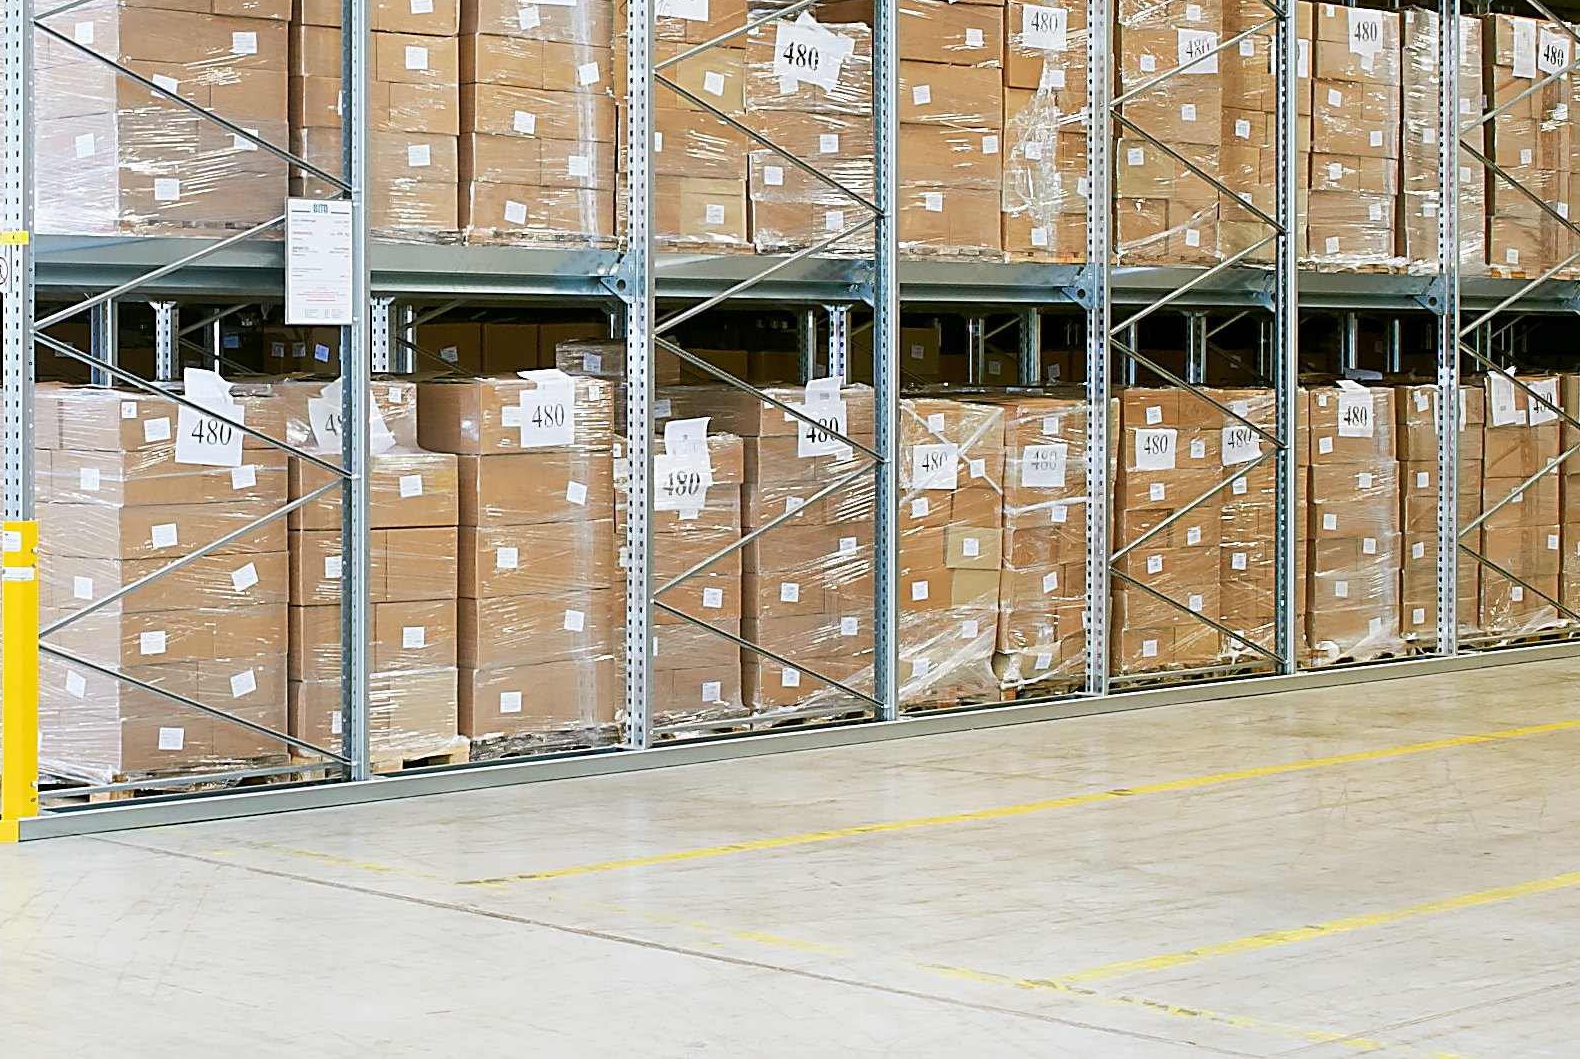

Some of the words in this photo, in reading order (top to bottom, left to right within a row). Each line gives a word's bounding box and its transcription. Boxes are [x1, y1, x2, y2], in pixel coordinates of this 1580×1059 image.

[1031, 12, 1059, 34] 480
[1354, 21, 1378, 42] 480
[782, 42, 820, 72] 480
[1186, 39, 1210, 58] 480
[1543, 43, 1564, 68] 480
[531, 402, 565, 428] 480
[1343, 405, 1368, 427] 480
[191, 418, 232, 446] 480
[805, 416, 839, 443] 480
[1227, 426, 1252, 449] 480
[1143, 434, 1169, 455] 480
[922, 451, 948, 472] 480
[663, 470, 701, 497] 480
